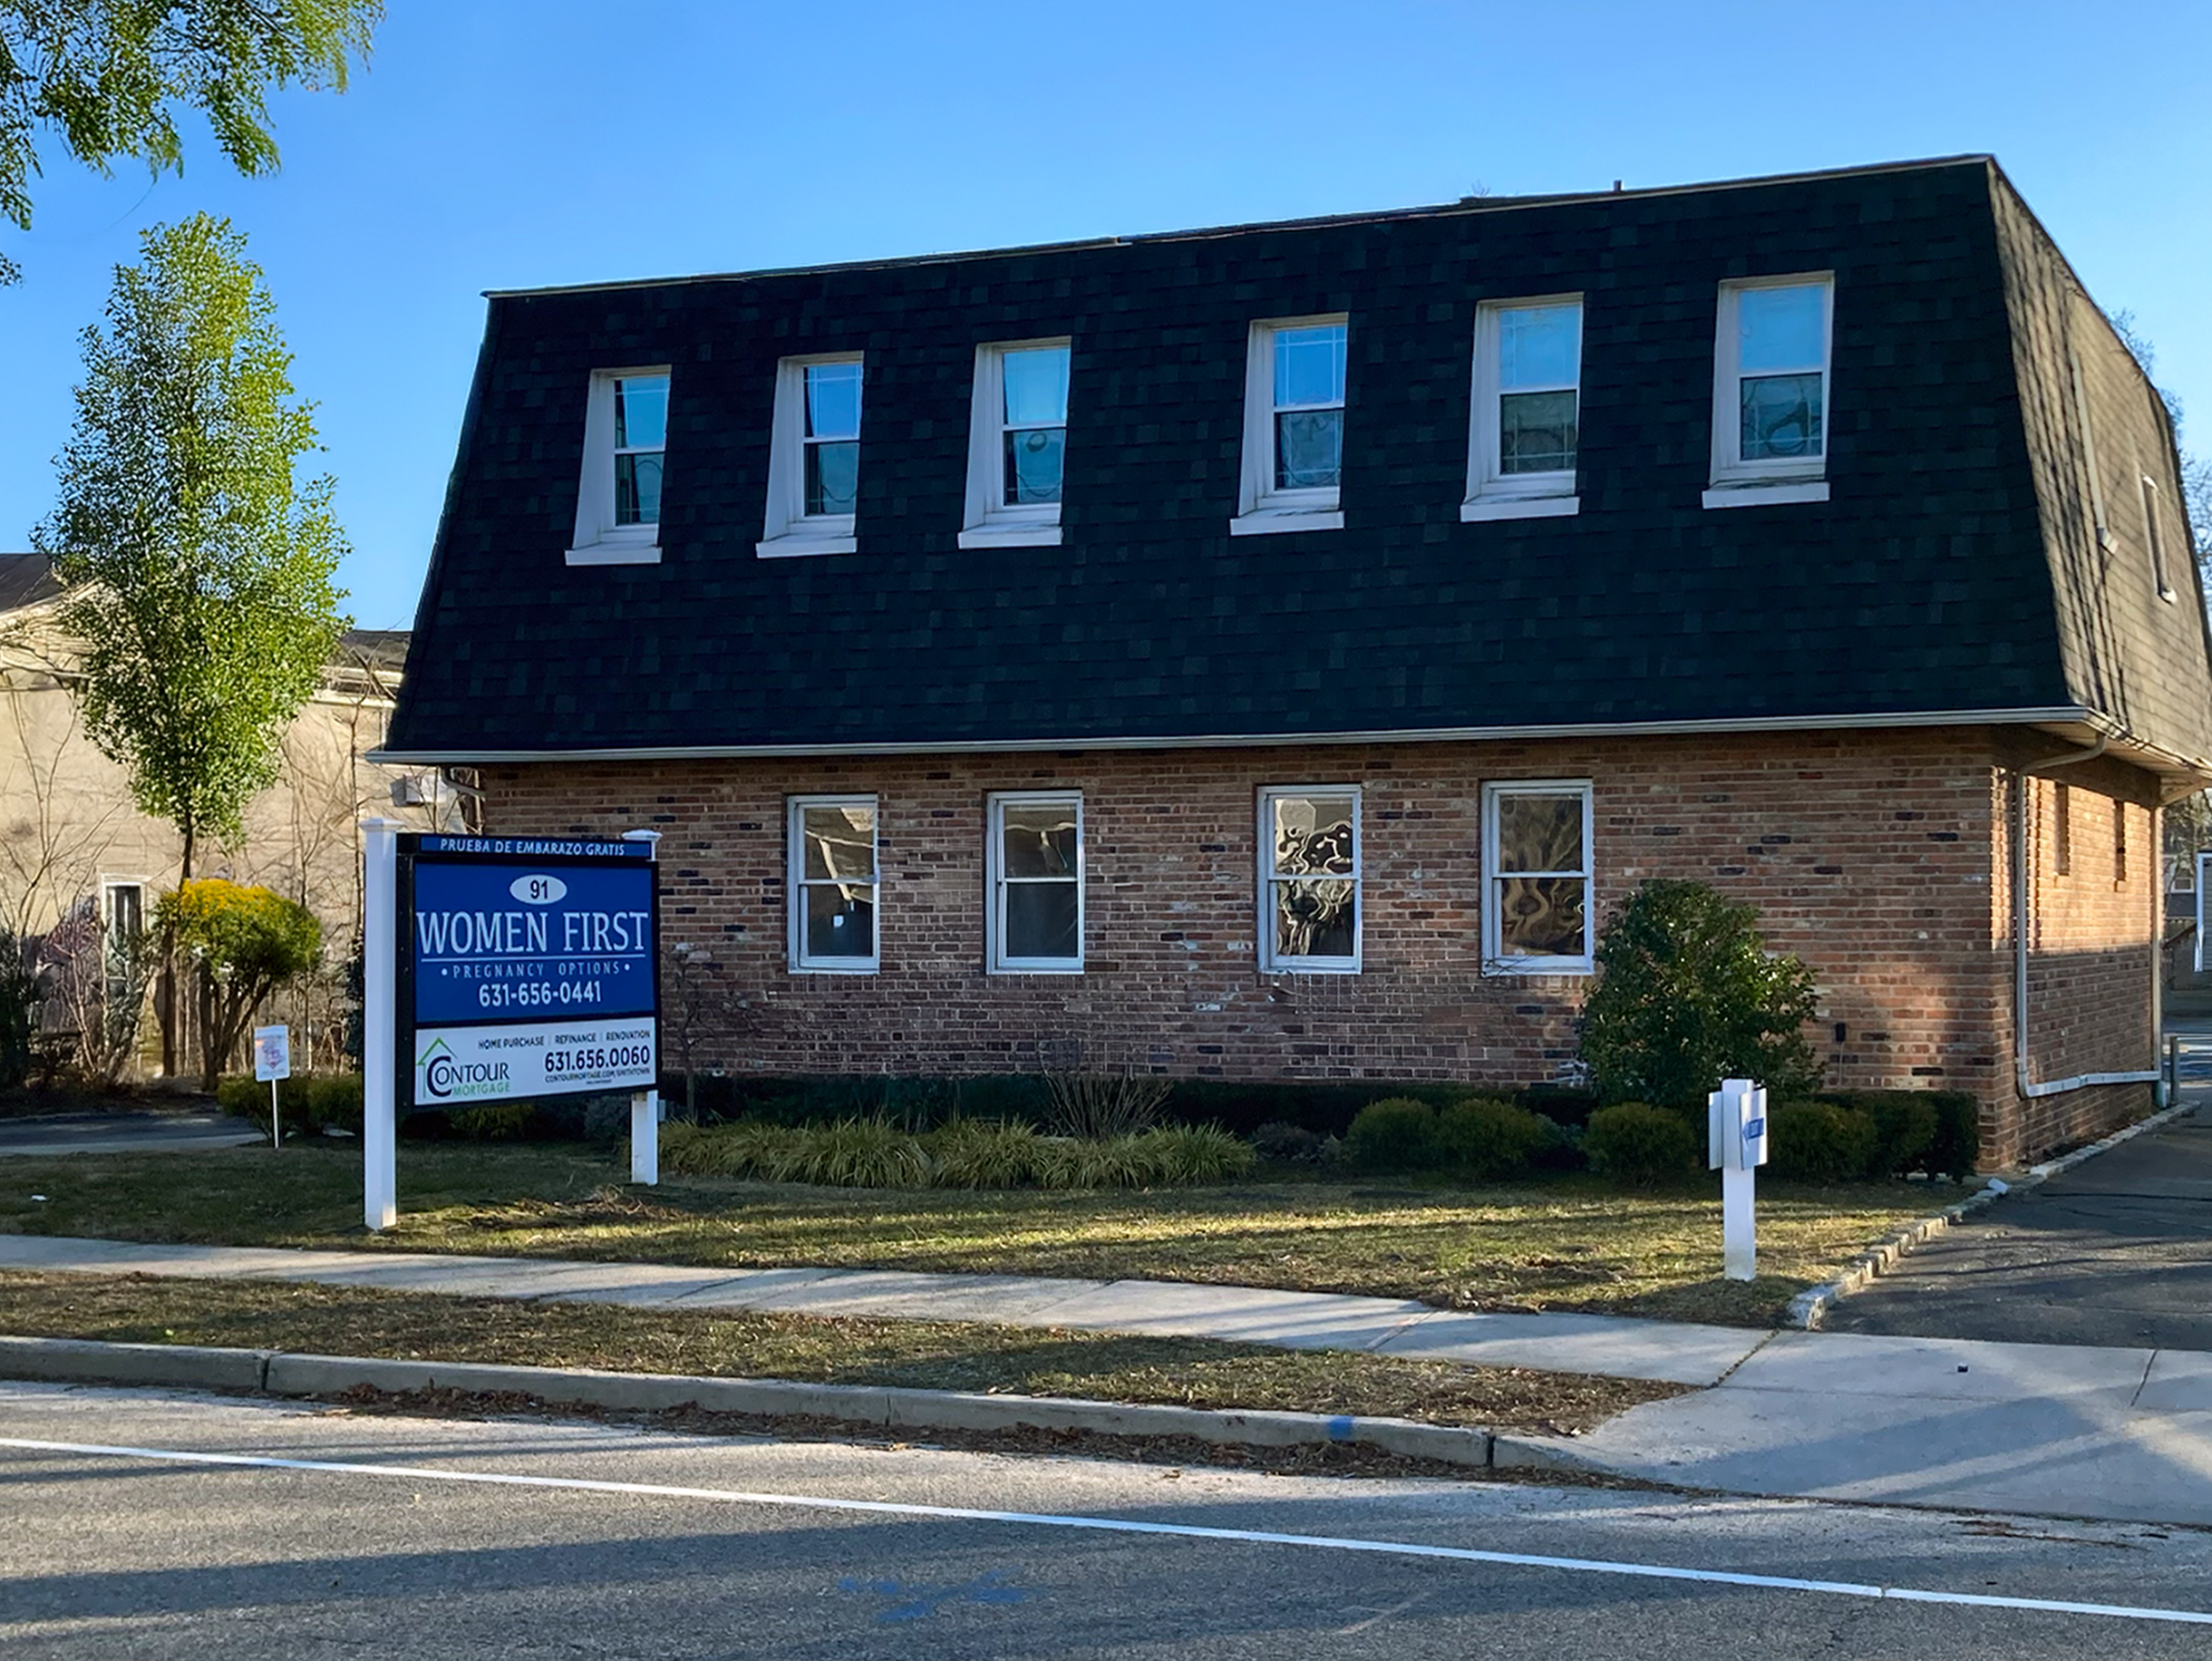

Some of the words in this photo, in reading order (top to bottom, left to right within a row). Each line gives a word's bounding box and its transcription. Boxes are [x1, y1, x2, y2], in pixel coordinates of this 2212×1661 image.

[440, 838, 490, 853] PRUEBA
[494, 840, 512, 854] DE
[516, 840, 583, 856] EMBARAZO
[586, 842, 626, 856] GRATIS
[529, 879, 548, 899] 91
[416, 910, 548, 954] WOMEN
[563, 910, 649, 952] FIRST
[453, 963, 544, 978] PREGNANCY
[558, 961, 620, 976] OPTIONS
[479, 980, 602, 1007] 631-656-0441
[478, 1038, 502, 1050] HOME
[503, 1035, 545, 1049] PURCHASE
[555, 1032, 597, 1044] REFINANCE
[606, 1029, 651, 1042] RENOVATION
[545, 1044, 651, 1073] 631.656.0060
[426, 1055, 510, 1097] CONTOUR
[454, 1082, 510, 1096] MORTGAGE
